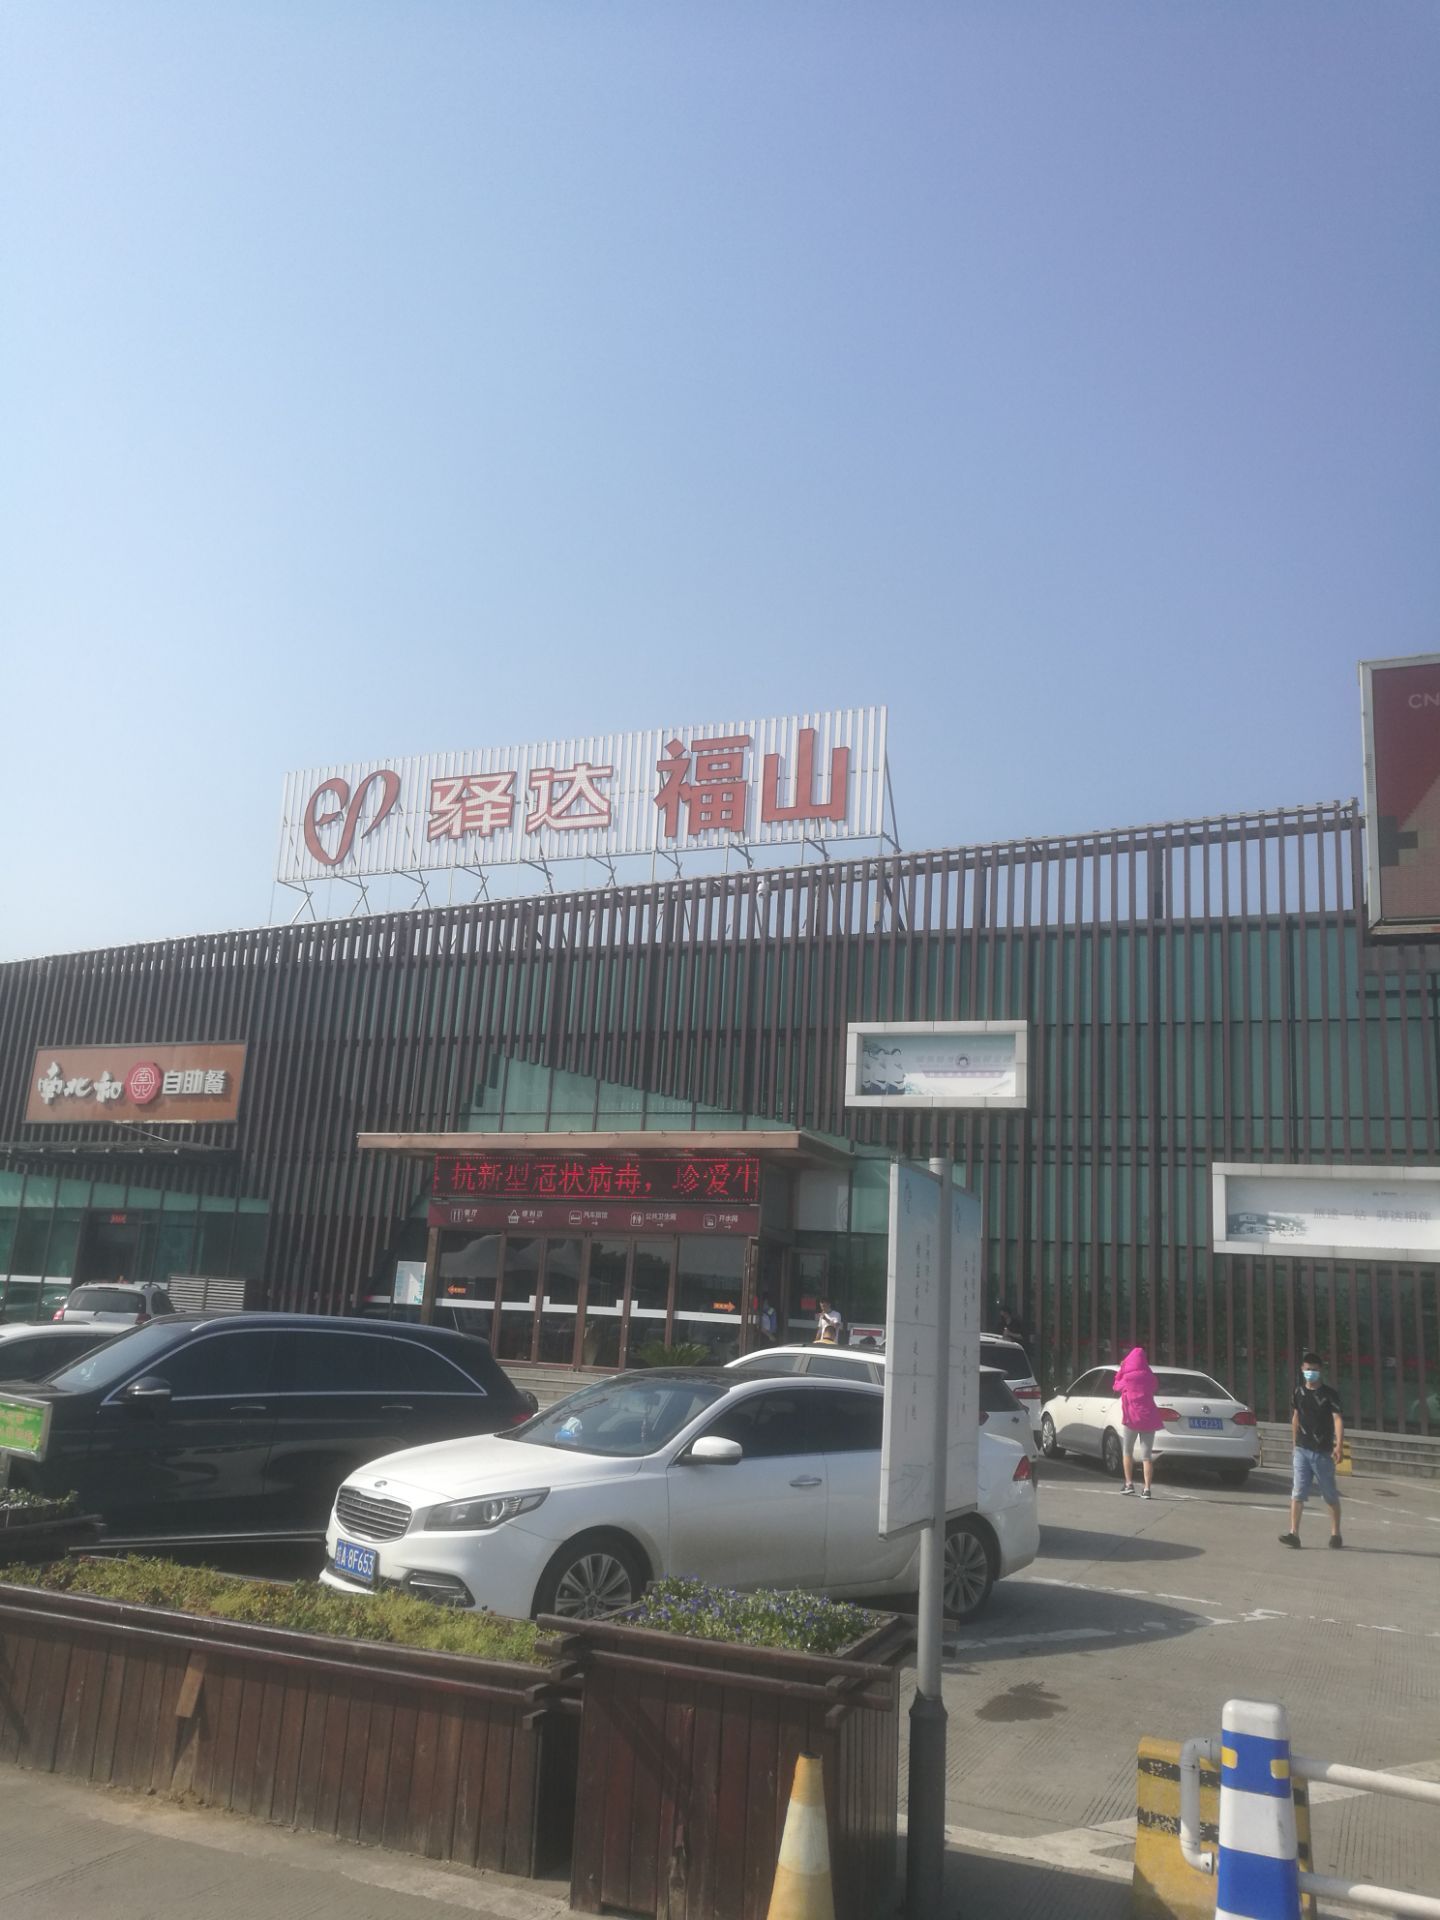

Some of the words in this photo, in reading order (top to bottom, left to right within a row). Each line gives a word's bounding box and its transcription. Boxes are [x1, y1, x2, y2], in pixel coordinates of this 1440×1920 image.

[427, 762, 613, 842] 驿达
[654, 728, 850, 838] 福山
[162, 1069, 225, 1095] 自助餐
